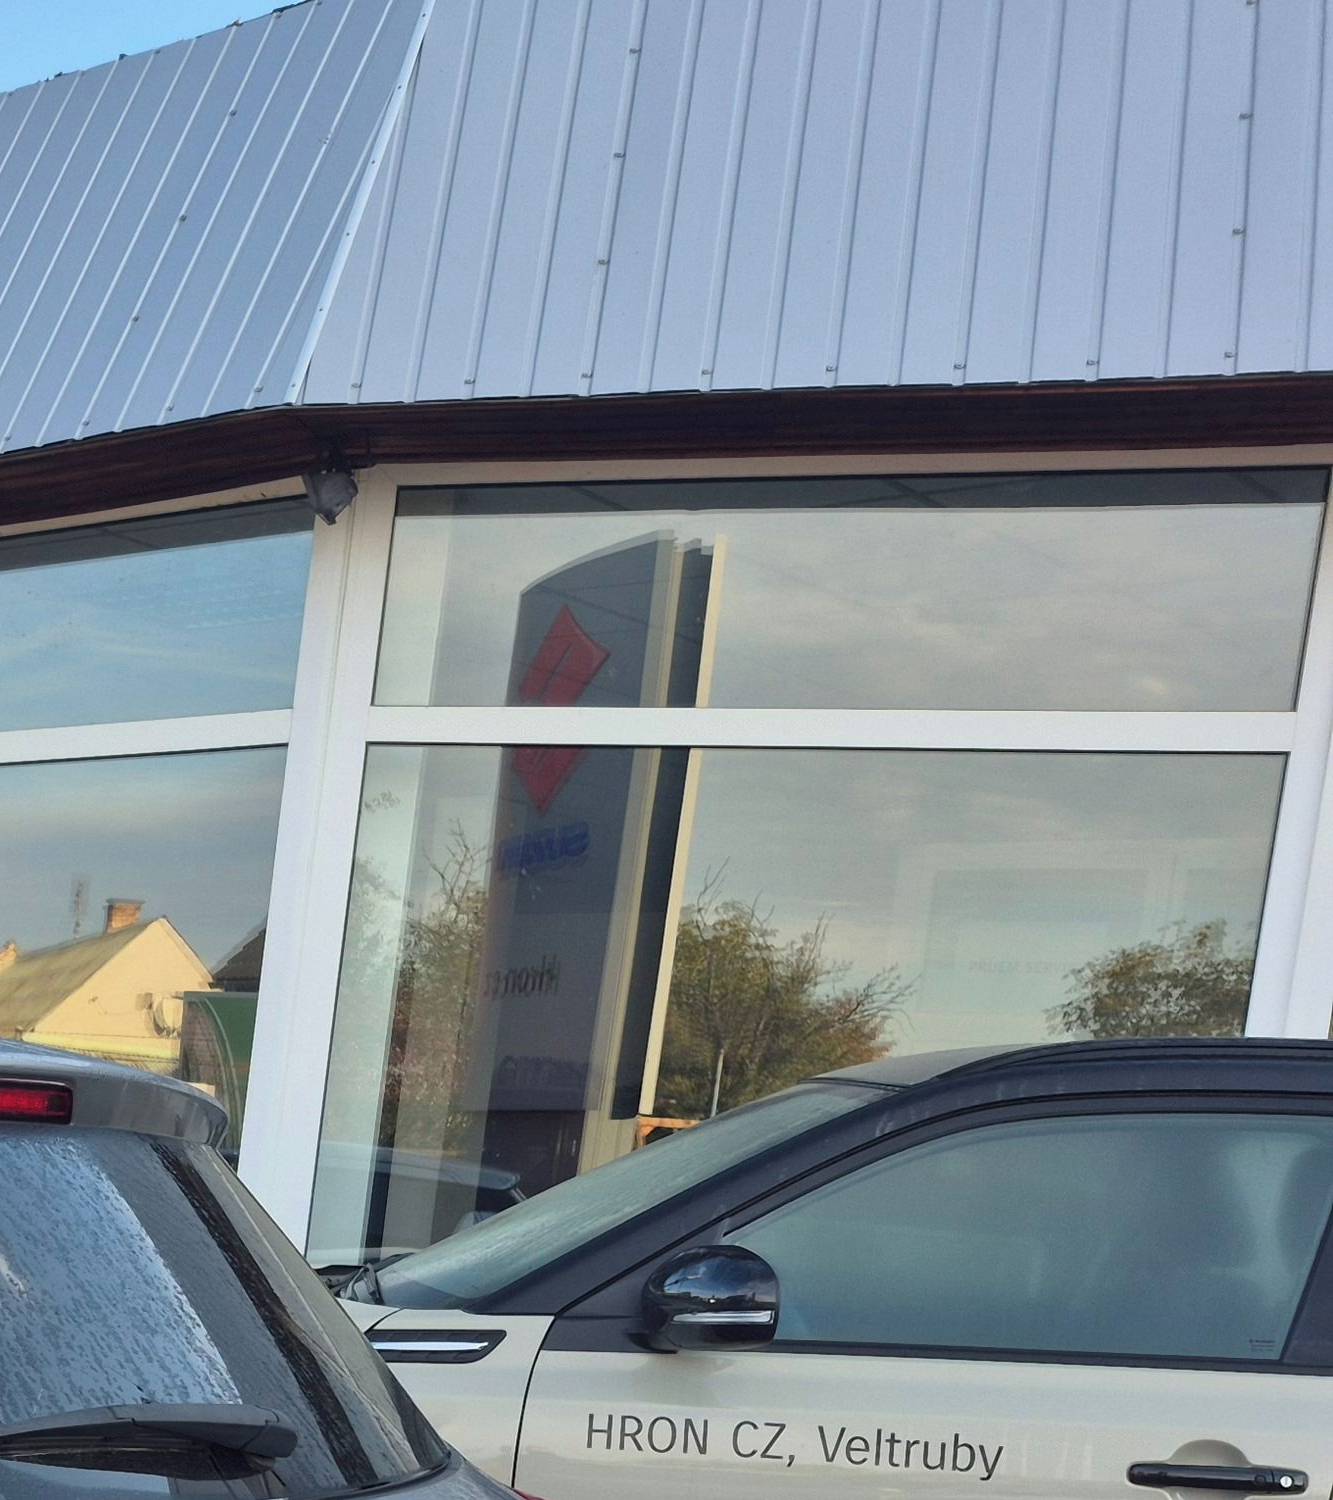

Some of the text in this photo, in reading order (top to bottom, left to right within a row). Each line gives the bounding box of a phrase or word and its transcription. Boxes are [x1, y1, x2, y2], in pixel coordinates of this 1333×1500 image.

[586, 1413, 1004, 1481] HRON CZ, Veltruby
